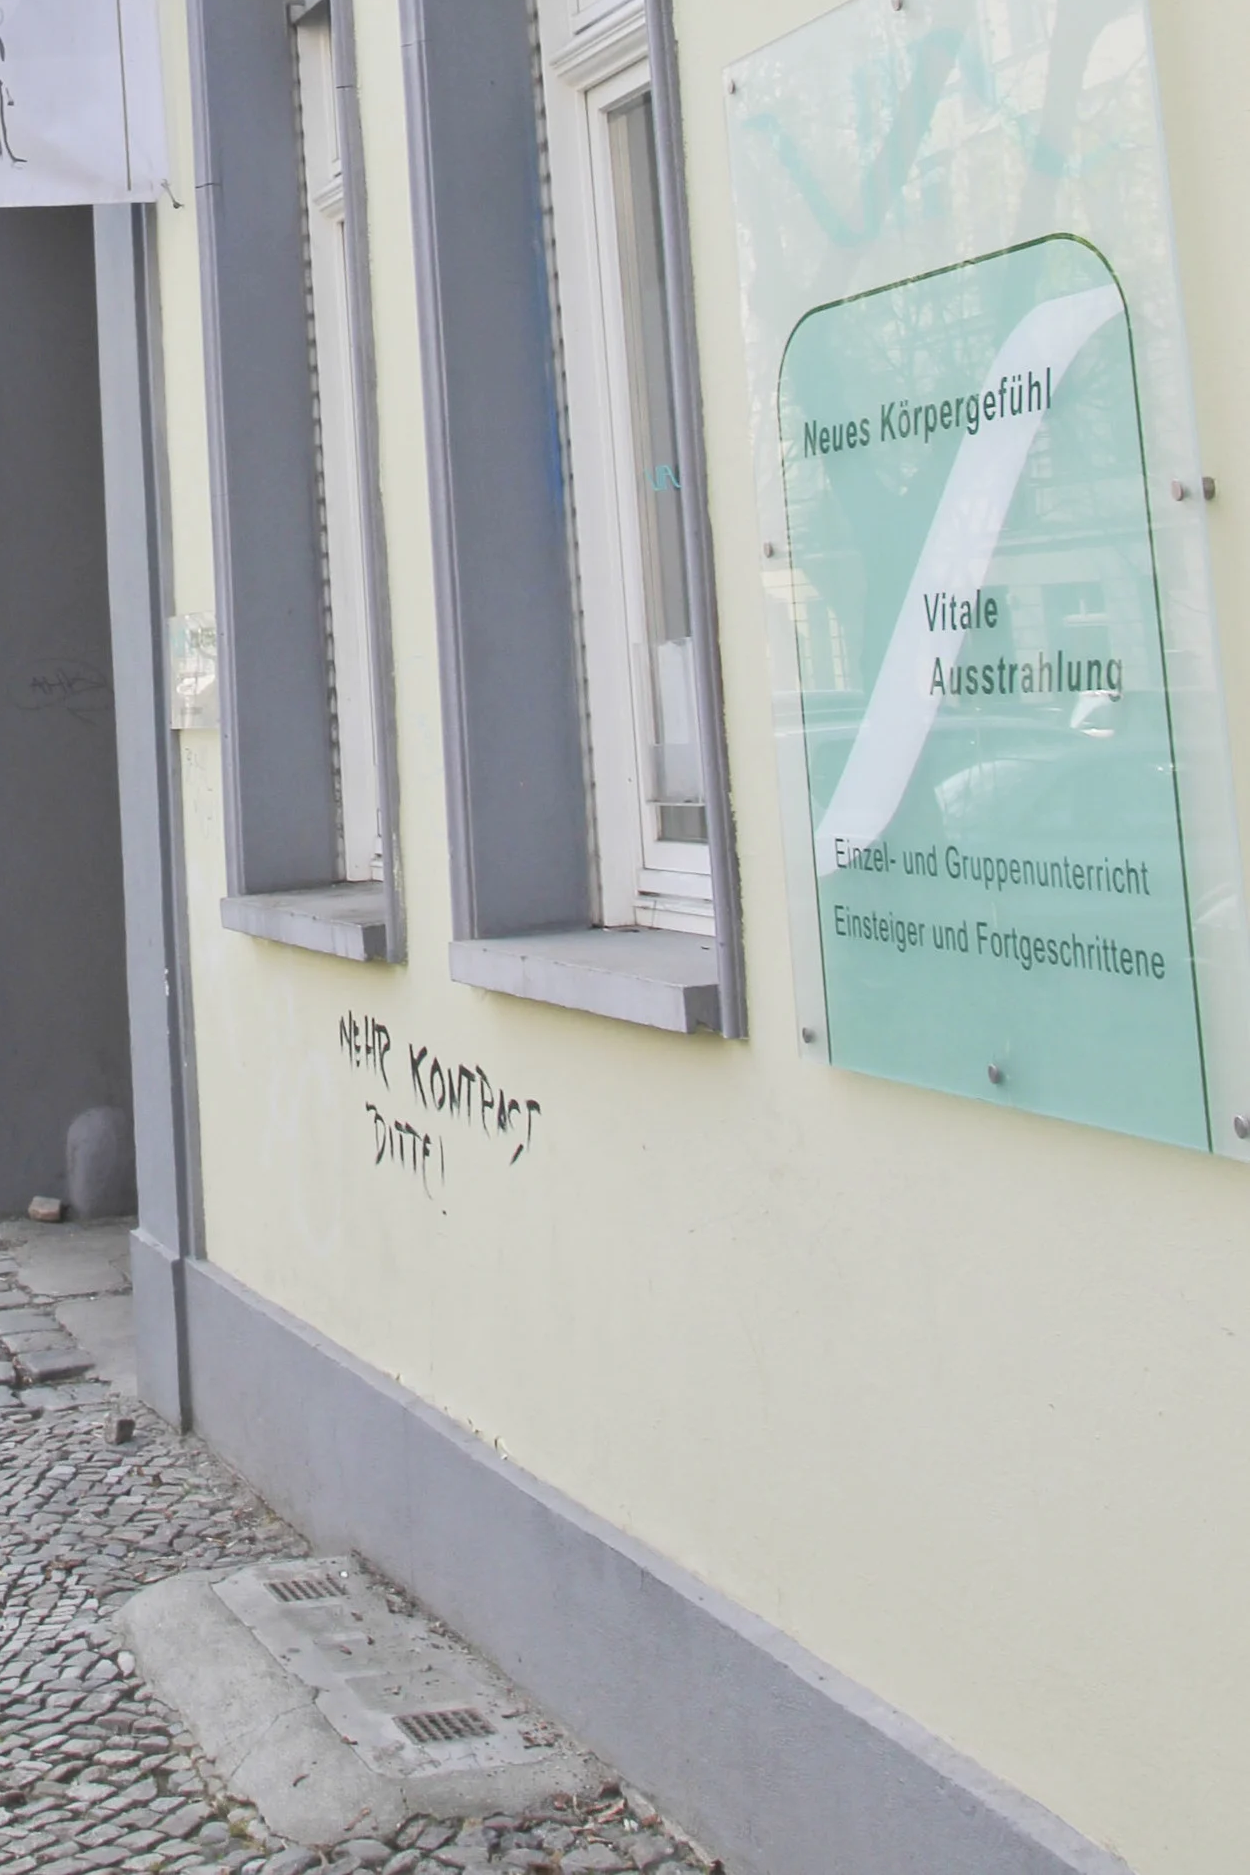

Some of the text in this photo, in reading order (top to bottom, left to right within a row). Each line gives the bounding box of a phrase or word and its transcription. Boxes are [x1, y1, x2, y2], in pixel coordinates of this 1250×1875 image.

[803, 366, 1053, 459] Neues Körpergefühl
[922, 589, 999, 633] Vitale
[929, 649, 1125, 701] Ausstrahlung
[833, 837, 1150, 897] Einzel- und Gruppenunterricht
[833, 905, 1167, 981] Einsteiger und Fortgeschrittene
